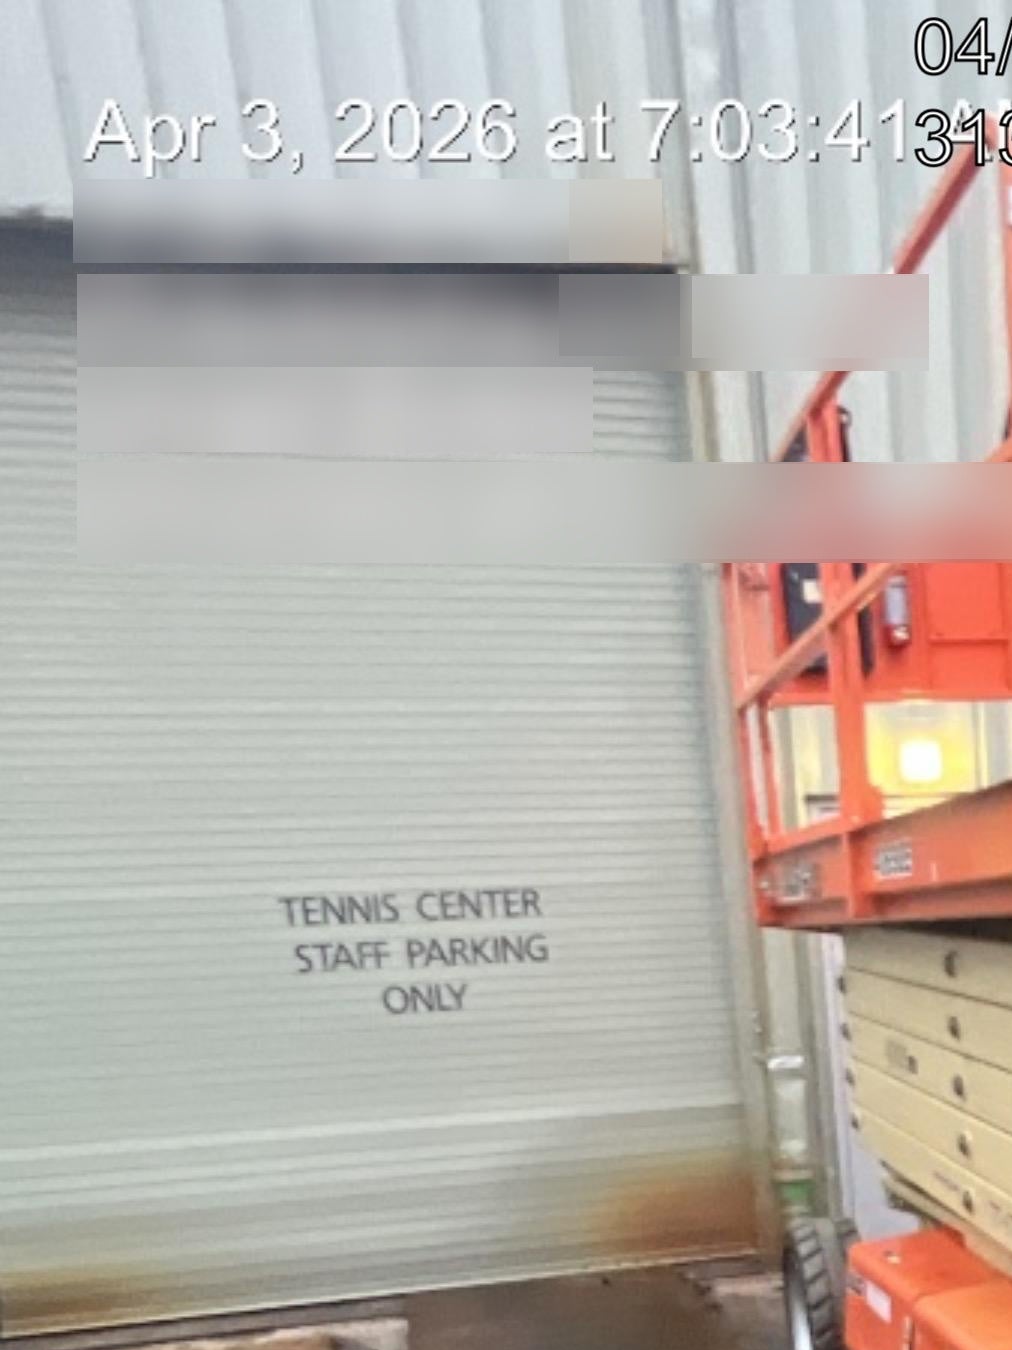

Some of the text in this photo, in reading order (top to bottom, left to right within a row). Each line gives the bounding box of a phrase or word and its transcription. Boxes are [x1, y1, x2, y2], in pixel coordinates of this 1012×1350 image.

[279, 888, 543, 926] TENNIS CENTER
[295, 934, 549, 973] STAFF PARKING
[382, 983, 468, 1014] ONLY
